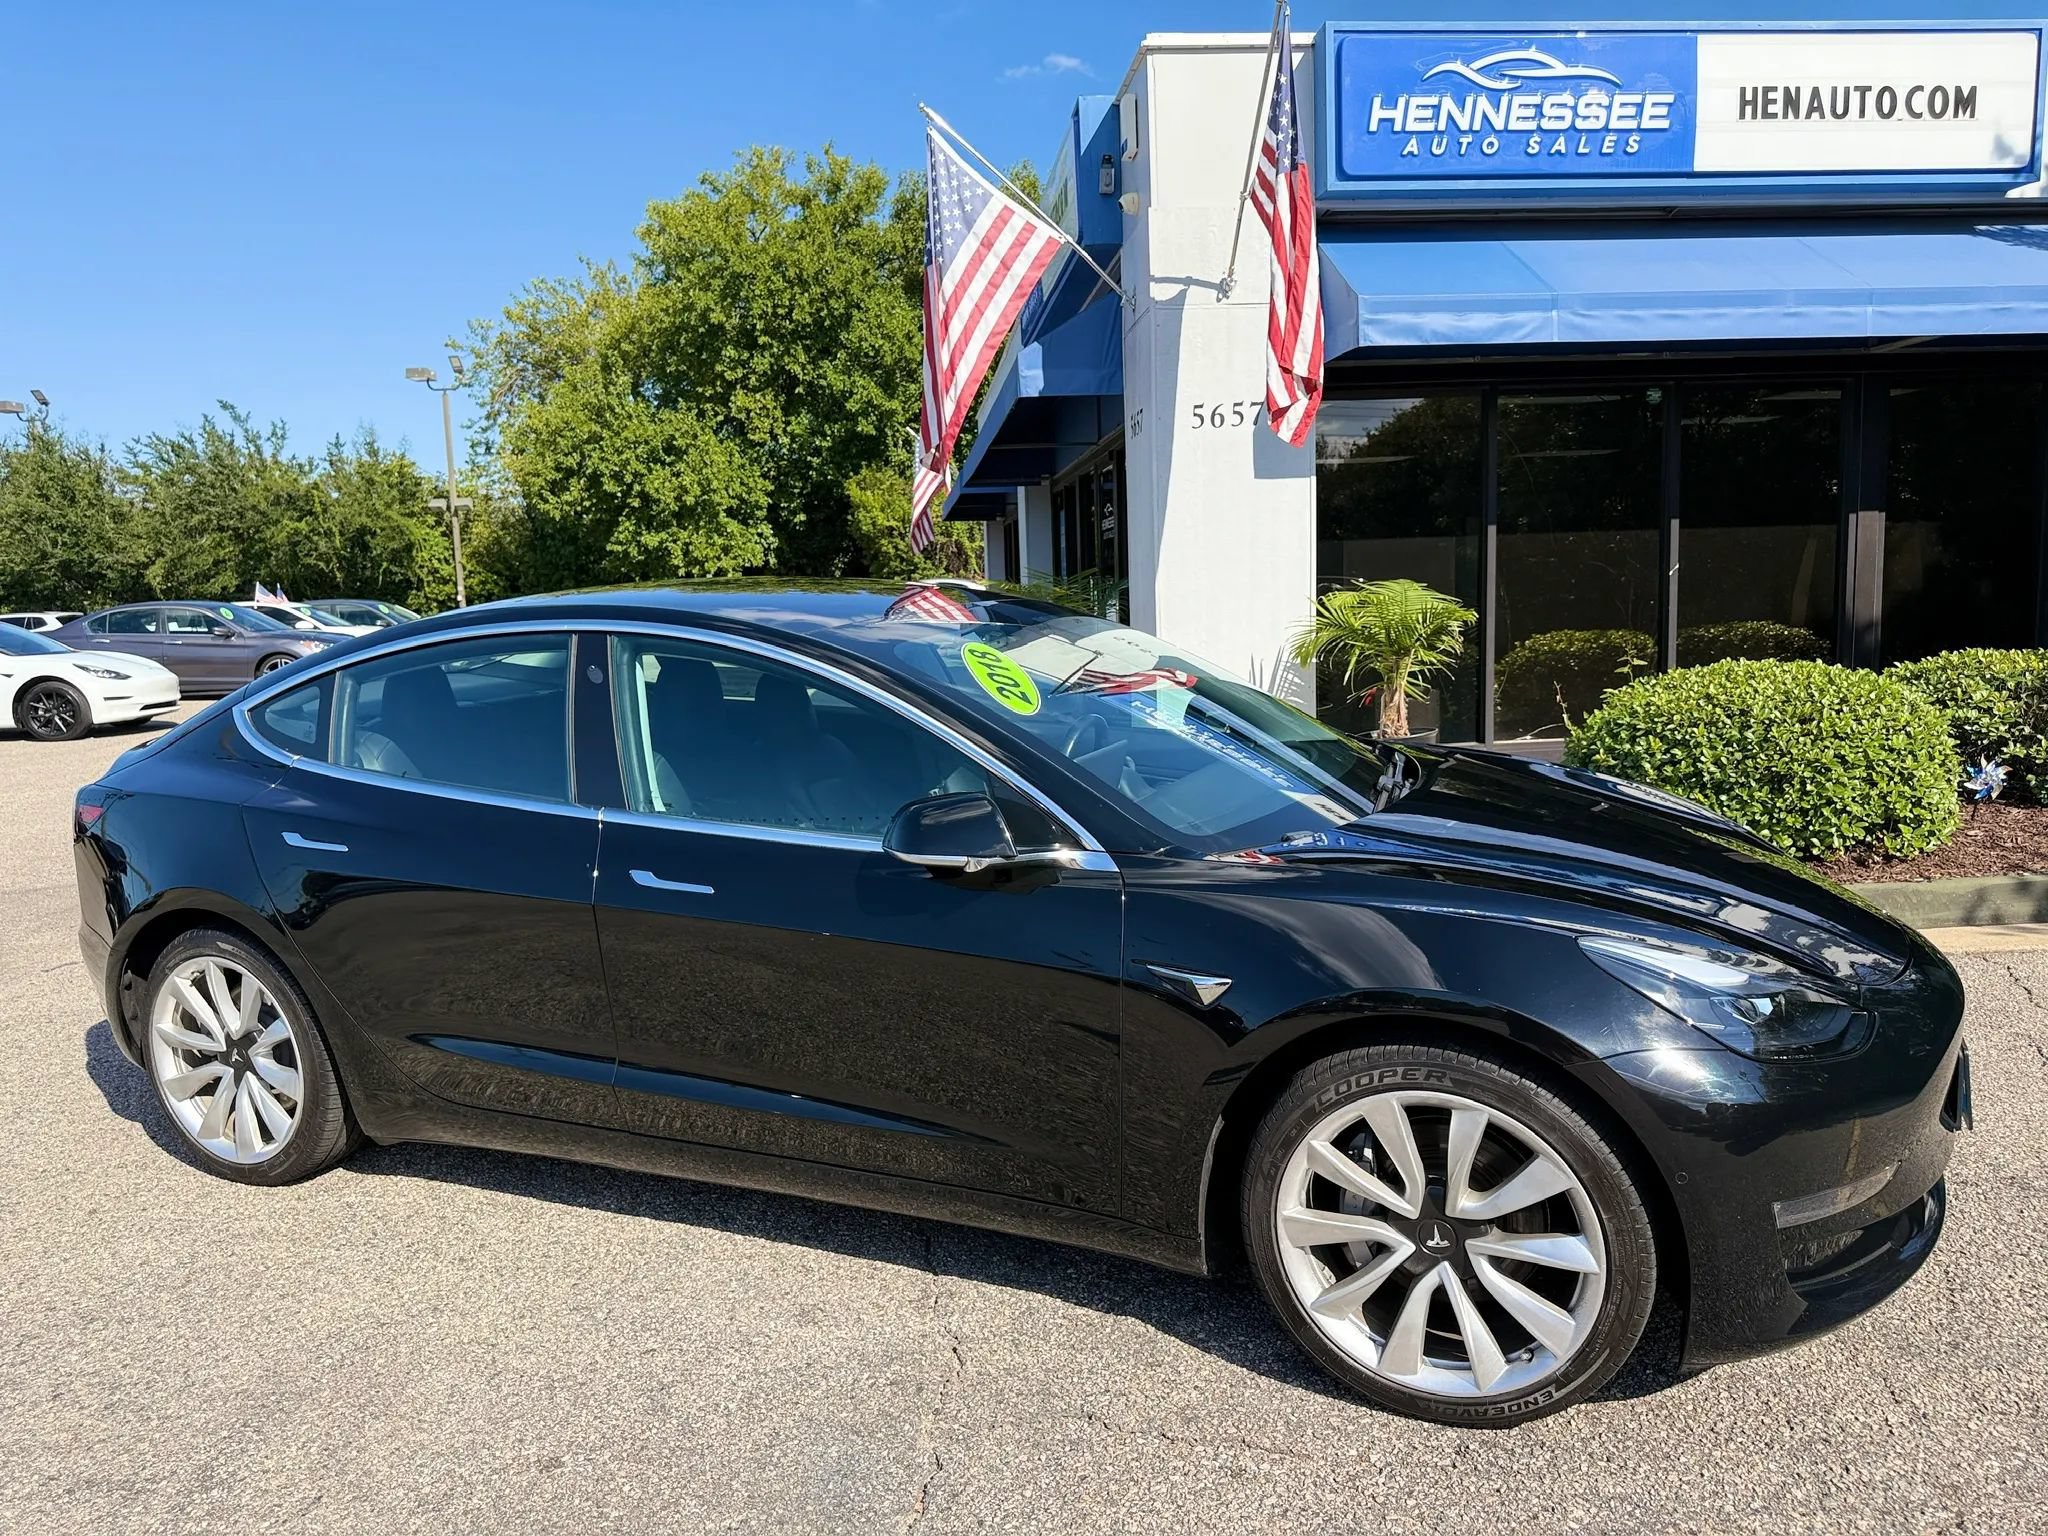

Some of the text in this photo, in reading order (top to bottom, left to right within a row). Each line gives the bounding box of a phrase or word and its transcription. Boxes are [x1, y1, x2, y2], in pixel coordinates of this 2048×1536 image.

[1367, 93, 1674, 132] HENNESSEE
[1738, 84, 1977, 121] HENAUTO.COM
[1401, 133, 1641, 155] AUTO SALES
[1130, 407, 1144, 439] 5657
[1191, 400, 1265, 429] 5657
[967, 648, 1034, 706] 2018
[1314, 1067, 1448, 1109] COOPER
